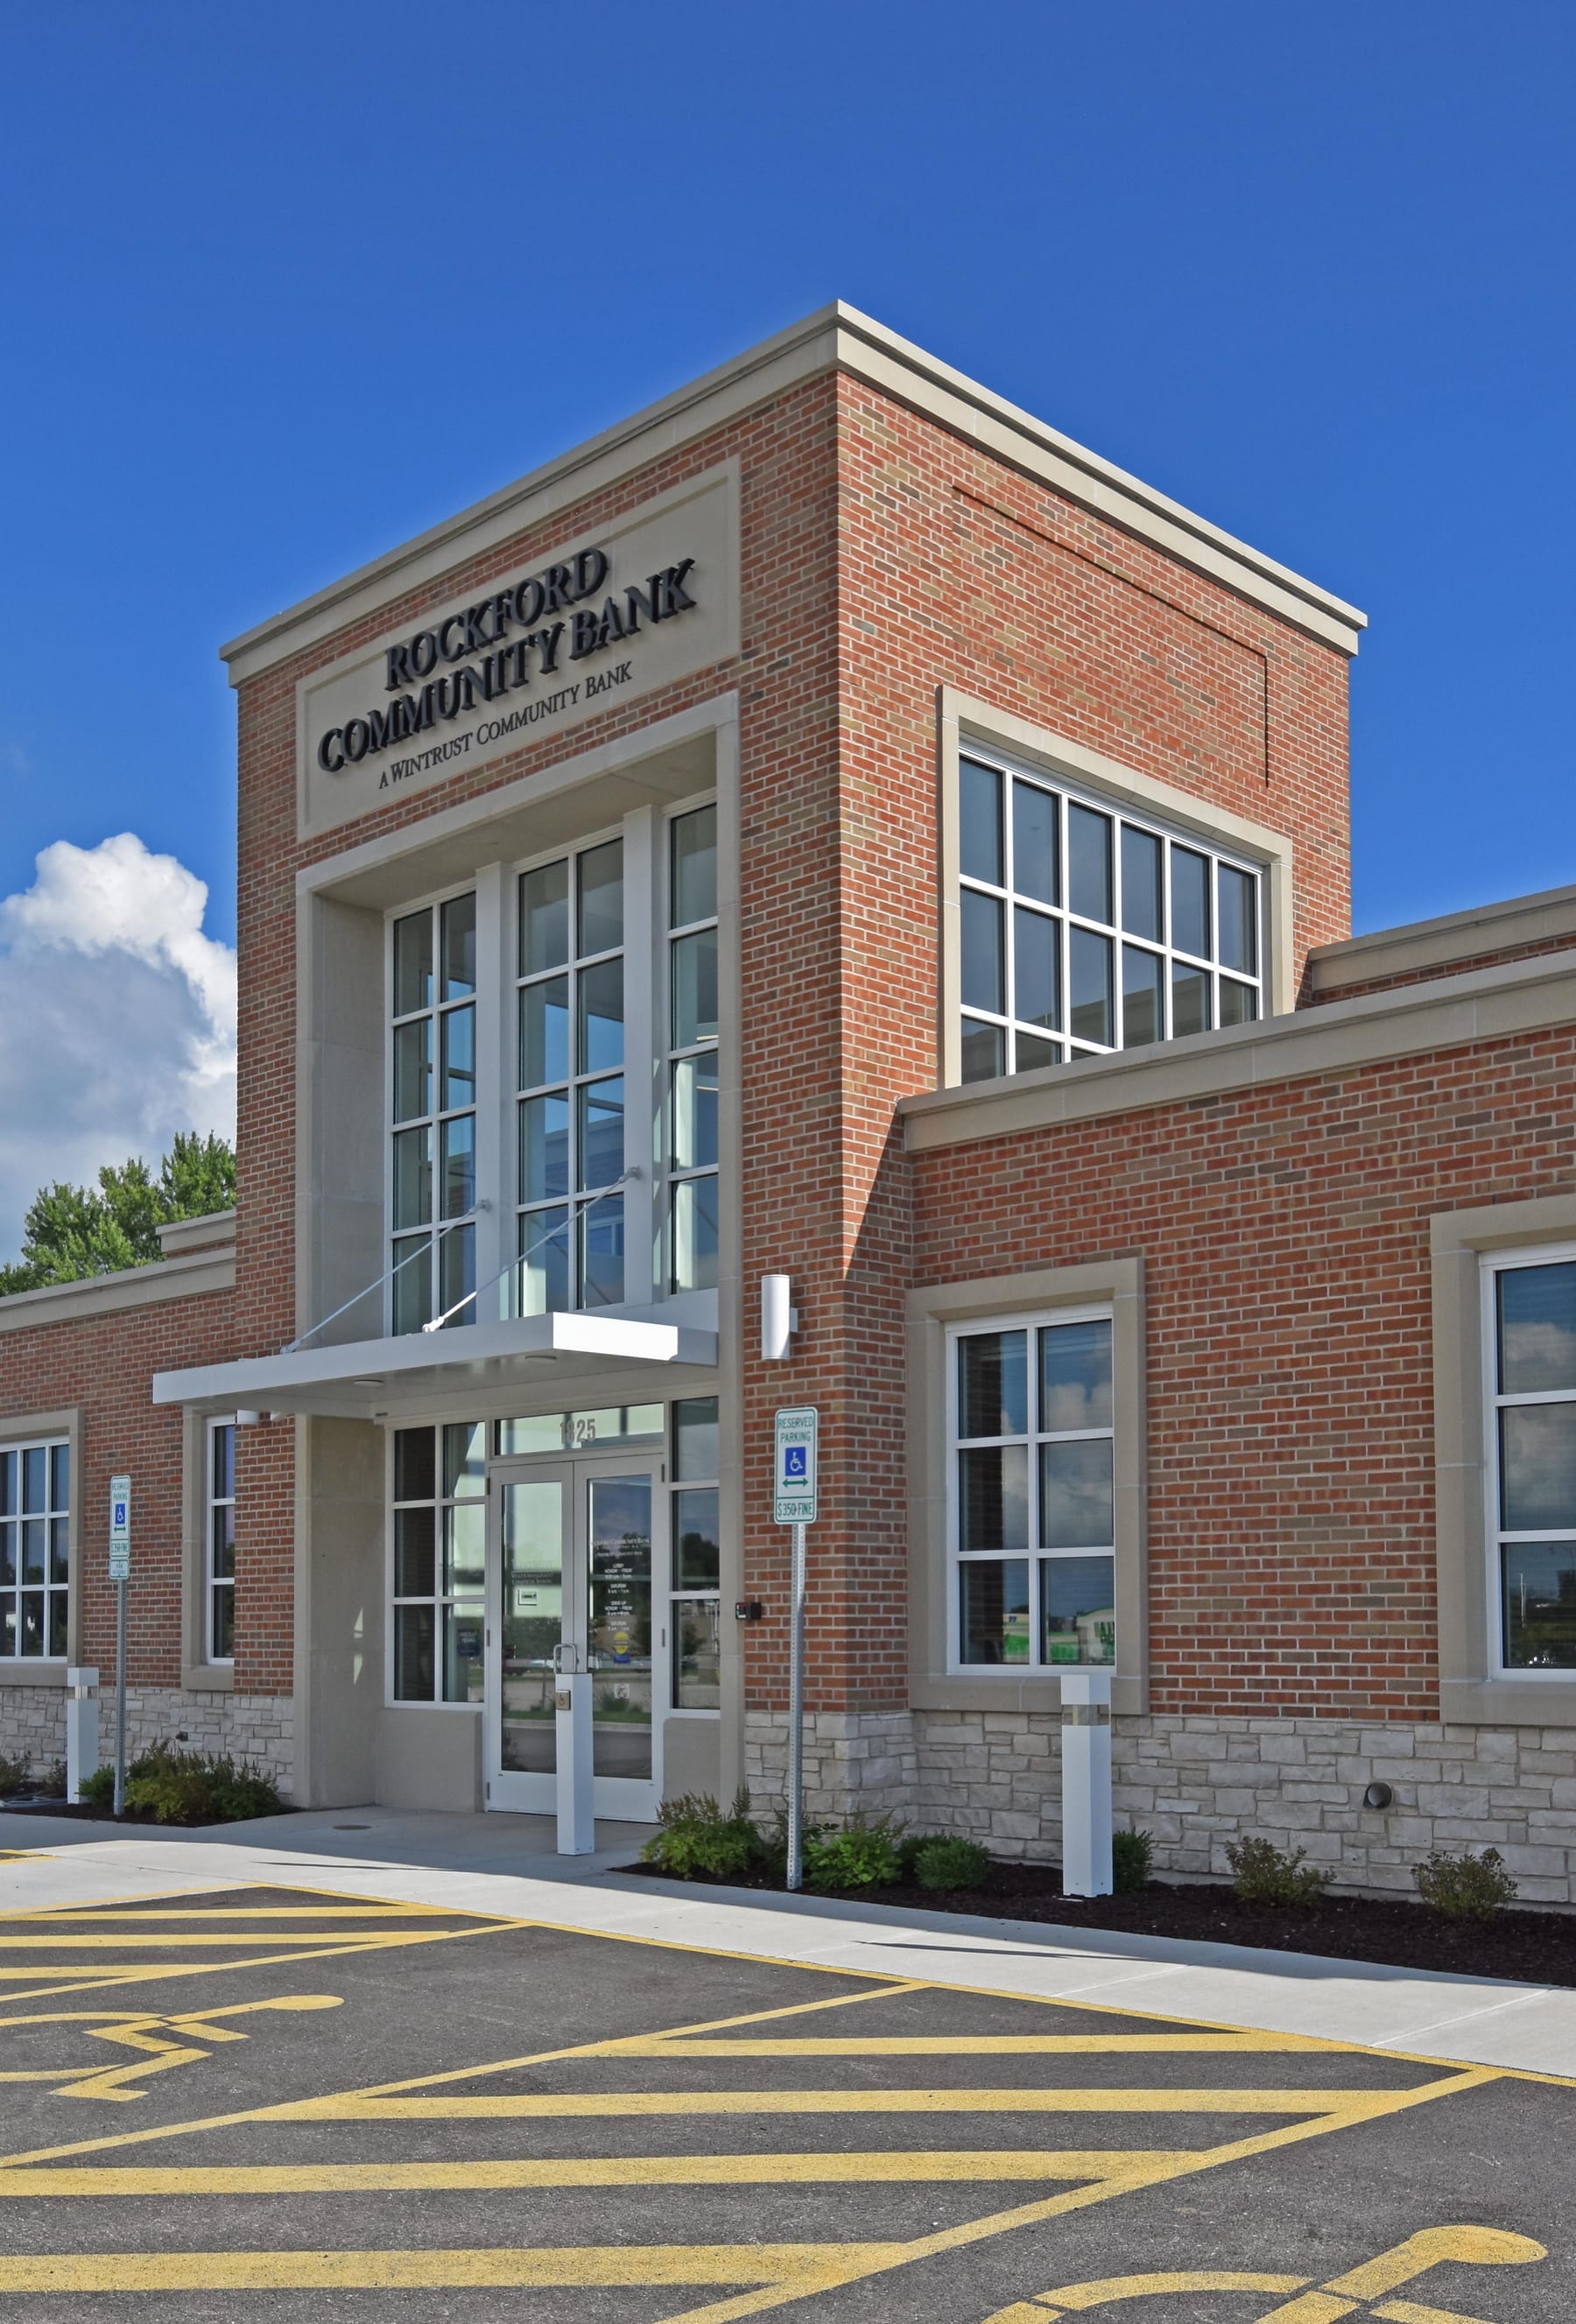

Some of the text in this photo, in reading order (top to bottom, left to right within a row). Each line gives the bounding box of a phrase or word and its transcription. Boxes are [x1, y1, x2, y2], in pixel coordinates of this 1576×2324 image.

[385, 547, 609, 692] ROCKFORD
[318, 558, 697, 772] COMMUNITY BANK
[378, 661, 633, 789] A WINTRUST COMMUNITY BANK
[560, 1418, 596, 1444] 1825
[777, 1416, 813, 1430] RESERVED
[780, 1431, 812, 1444] PARKING
[777, 1502, 813, 1517] $350 FINE
